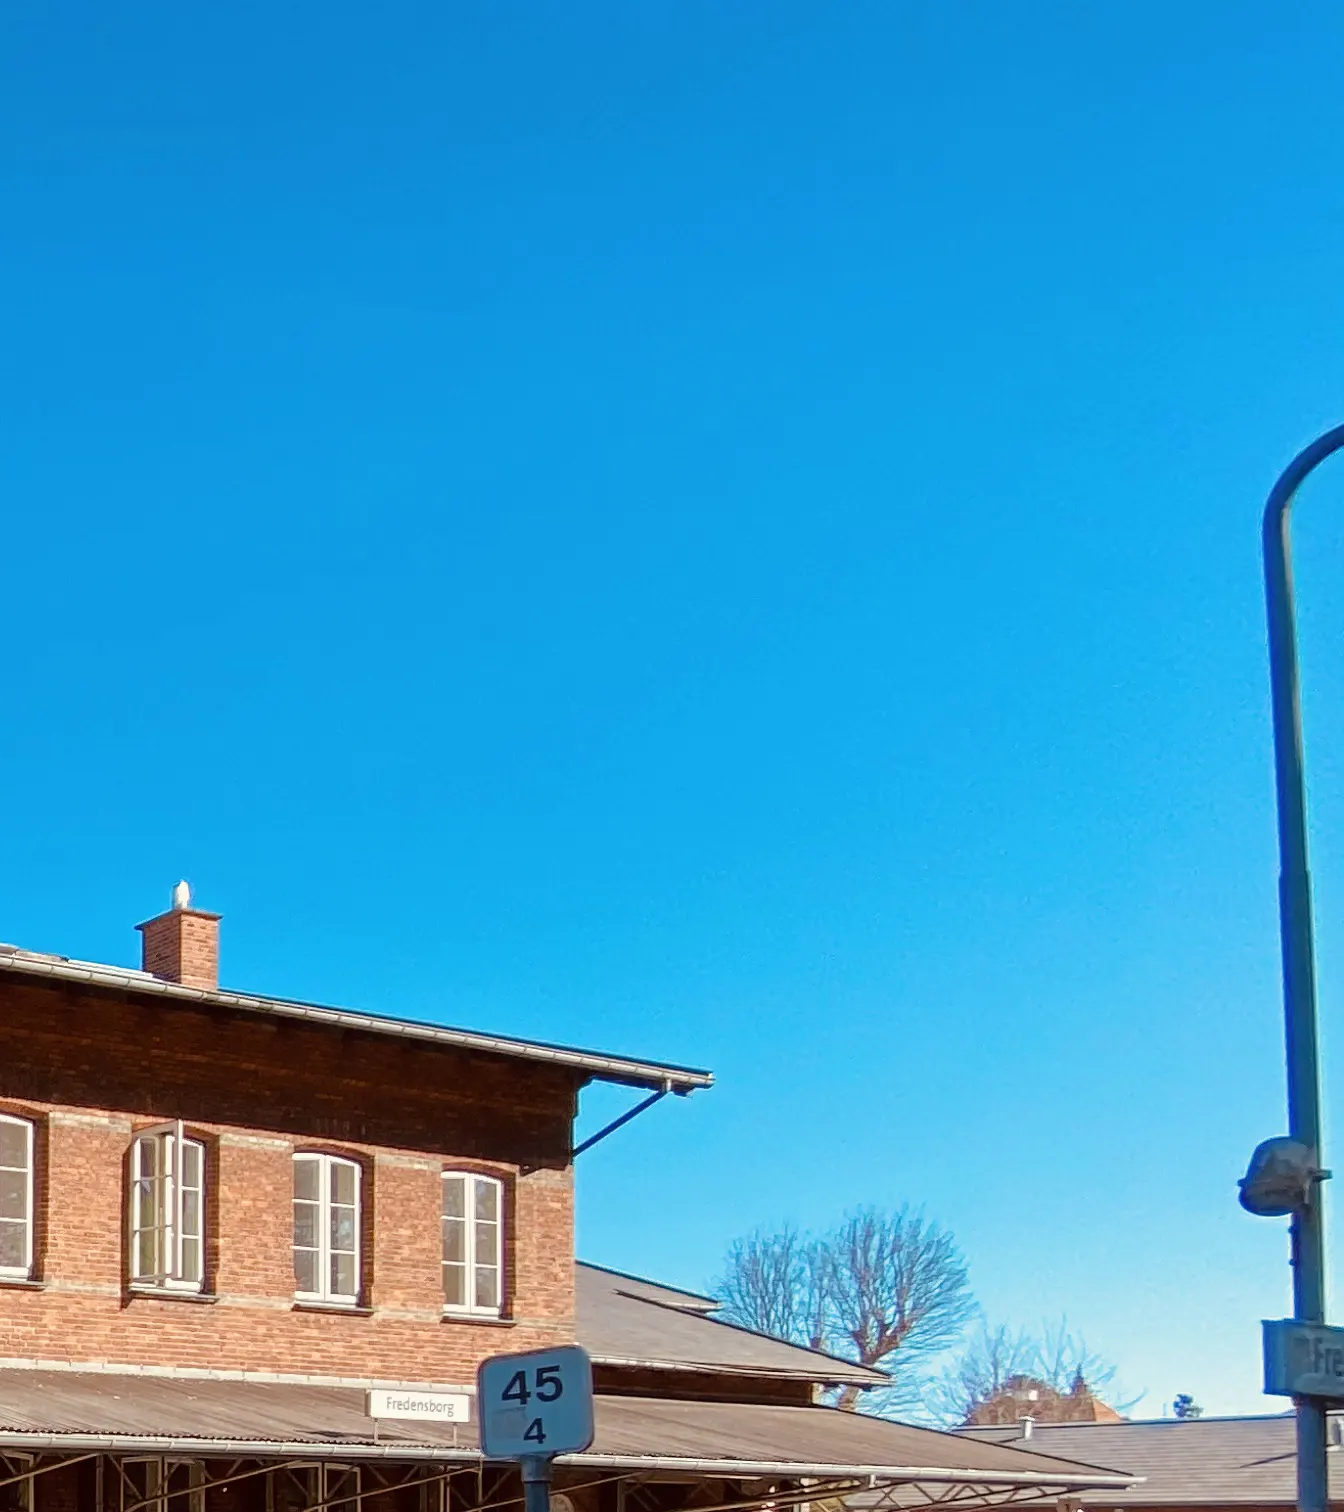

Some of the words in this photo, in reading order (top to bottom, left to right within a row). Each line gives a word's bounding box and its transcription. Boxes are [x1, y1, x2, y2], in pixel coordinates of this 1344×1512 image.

[501, 1365, 563, 1405] 45
[386, 1396, 455, 1418] Fredensborg
[523, 1417, 547, 1445] 4
